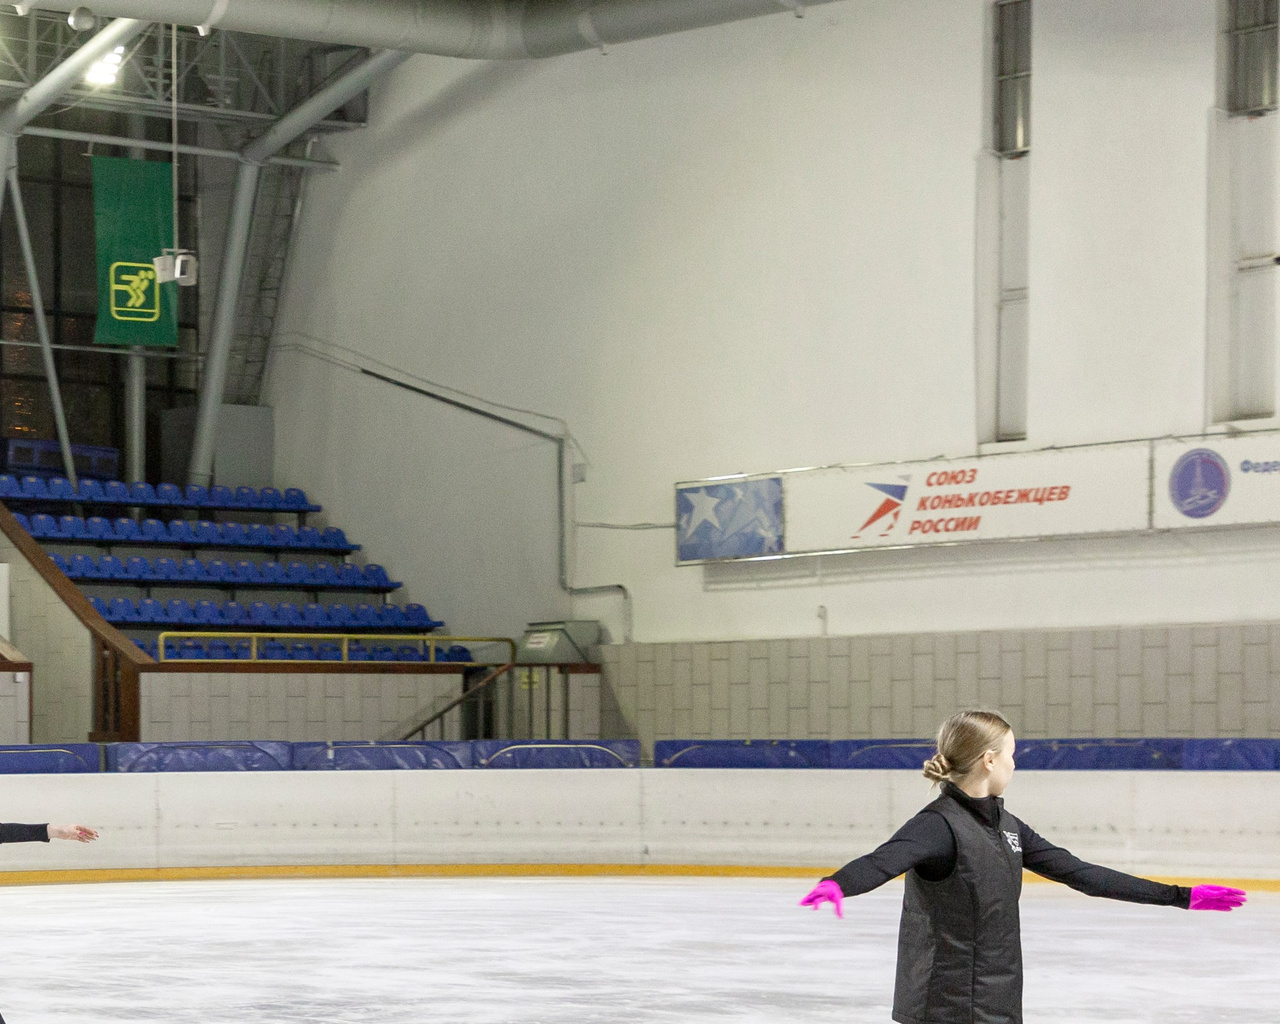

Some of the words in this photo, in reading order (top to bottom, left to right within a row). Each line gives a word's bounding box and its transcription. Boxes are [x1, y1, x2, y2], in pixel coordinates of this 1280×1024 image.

[925, 468, 978, 488] СОЮЗ
[916, 485, 1071, 512] КОНЬКОБЕЖЦЕВ
[908, 515, 981, 535] РОССИИ
